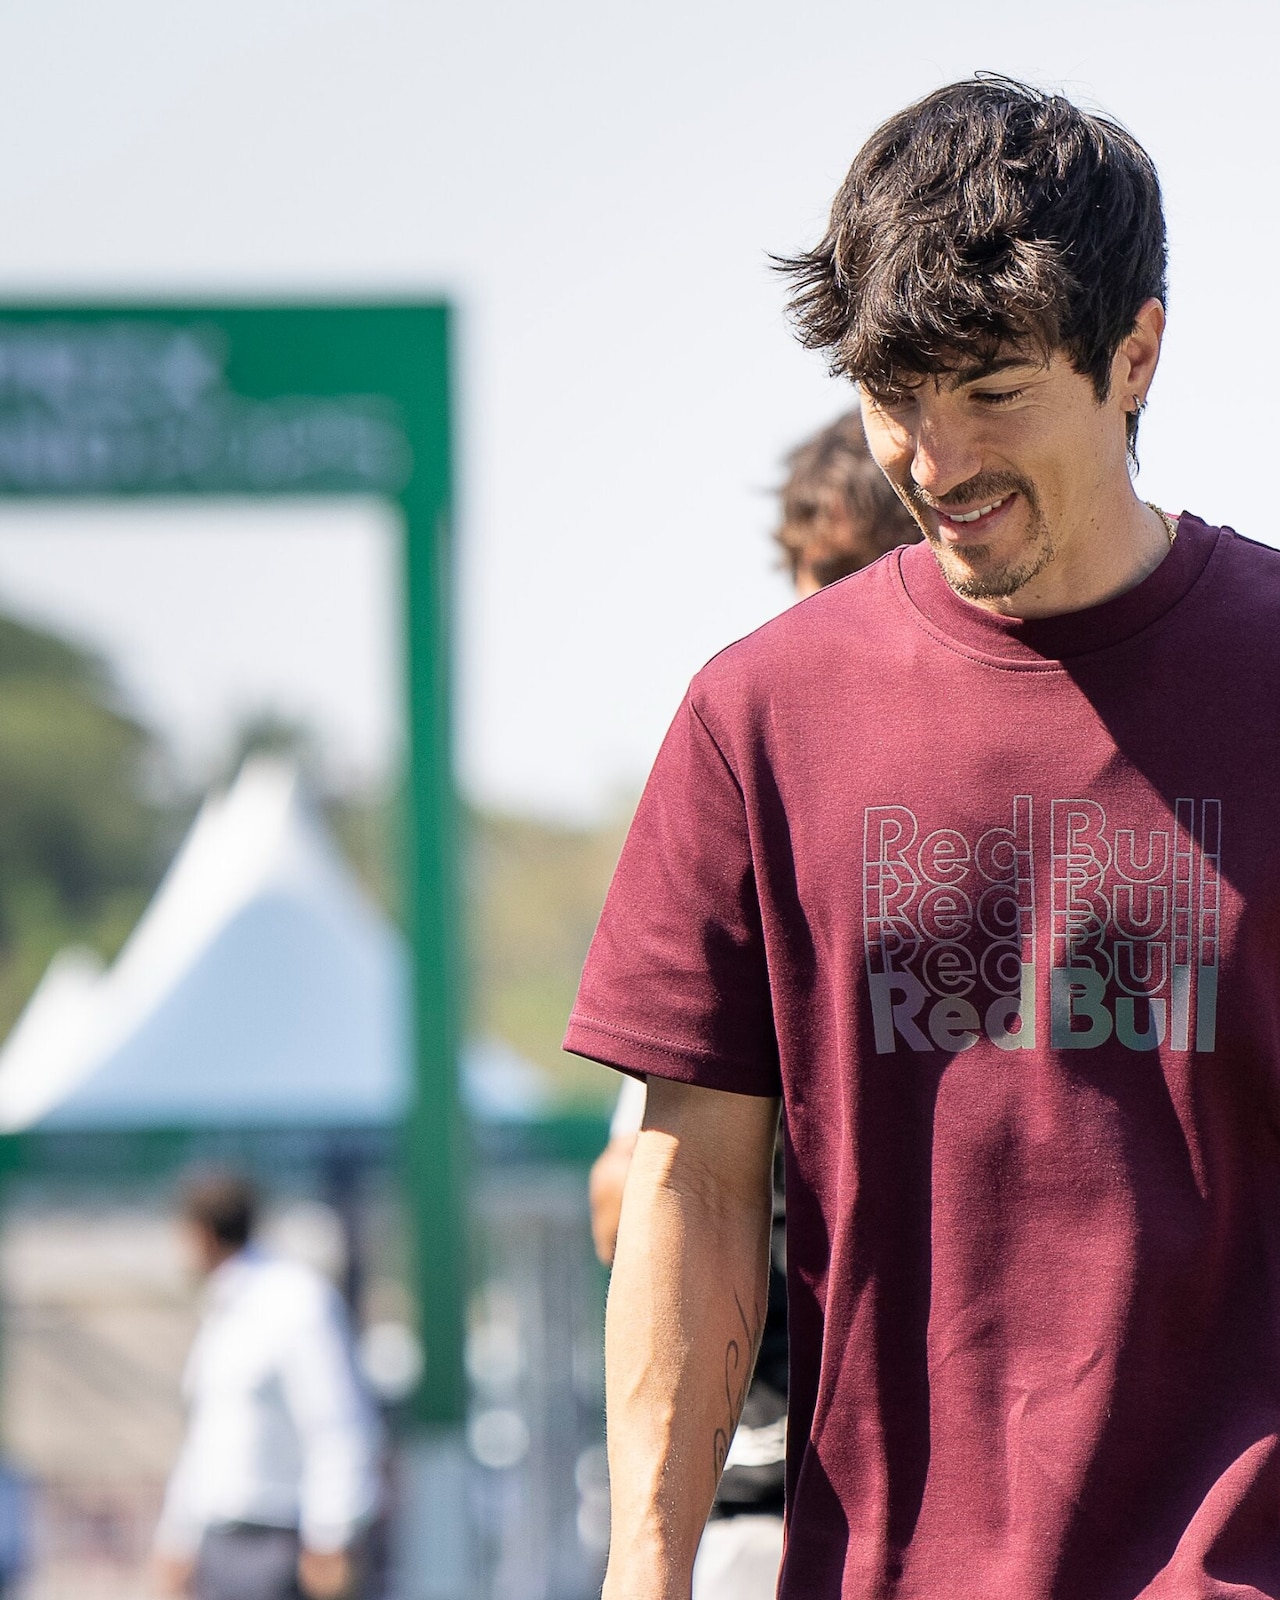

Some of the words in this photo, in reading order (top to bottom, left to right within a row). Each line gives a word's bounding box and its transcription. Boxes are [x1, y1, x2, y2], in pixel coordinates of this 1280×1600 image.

[864, 795, 1034, 887] Red
[1051, 798, 1221, 883] Bull
[863, 851, 1035, 943] Red
[1051, 853, 1220, 939] Bull
[865, 907, 1036, 998] Red
[1051, 908, 1219, 996] Bull
[869, 963, 1036, 1054] Red
[1051, 964, 1217, 1053] Bull
